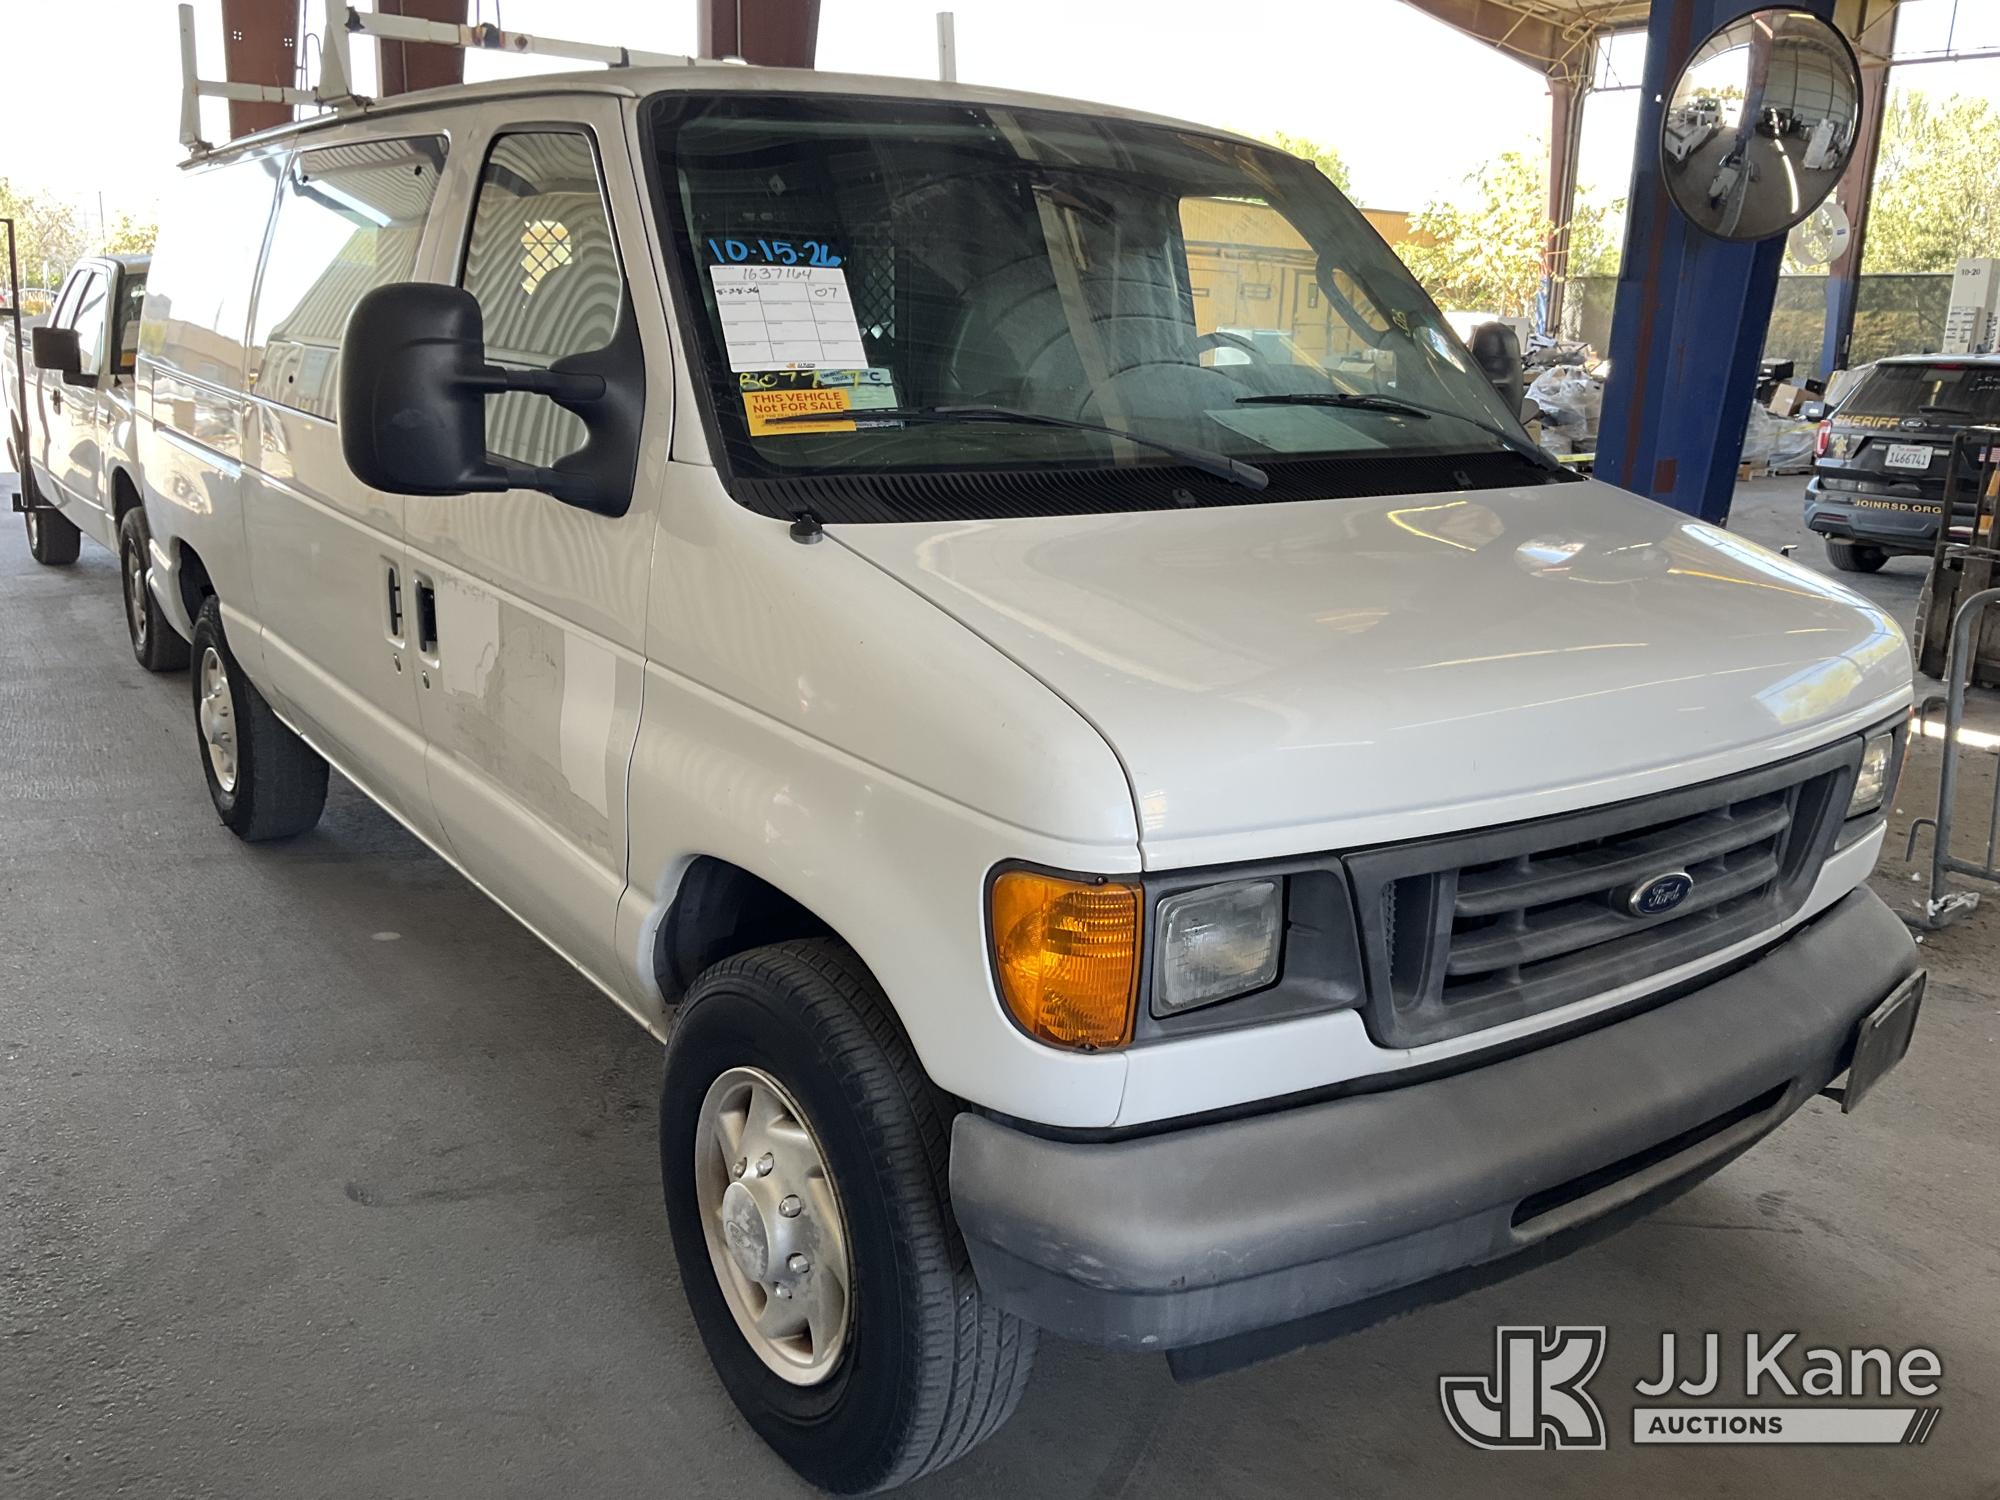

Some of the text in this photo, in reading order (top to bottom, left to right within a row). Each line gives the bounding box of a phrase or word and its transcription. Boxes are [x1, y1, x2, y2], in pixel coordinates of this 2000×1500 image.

[709, 239, 842, 267] 10-15-26
[743, 268, 812, 280] 1637164
[752, 392, 841, 403] THIS VEHICLE
[753, 401, 844, 413] Not FOR SALE
[1834, 414, 1900, 428] SHERIFF
[1889, 453, 1927, 465] 1466741
[1853, 499, 1942, 514] JOINRSD.ORG
[1648, 882, 1681, 907] Ford
